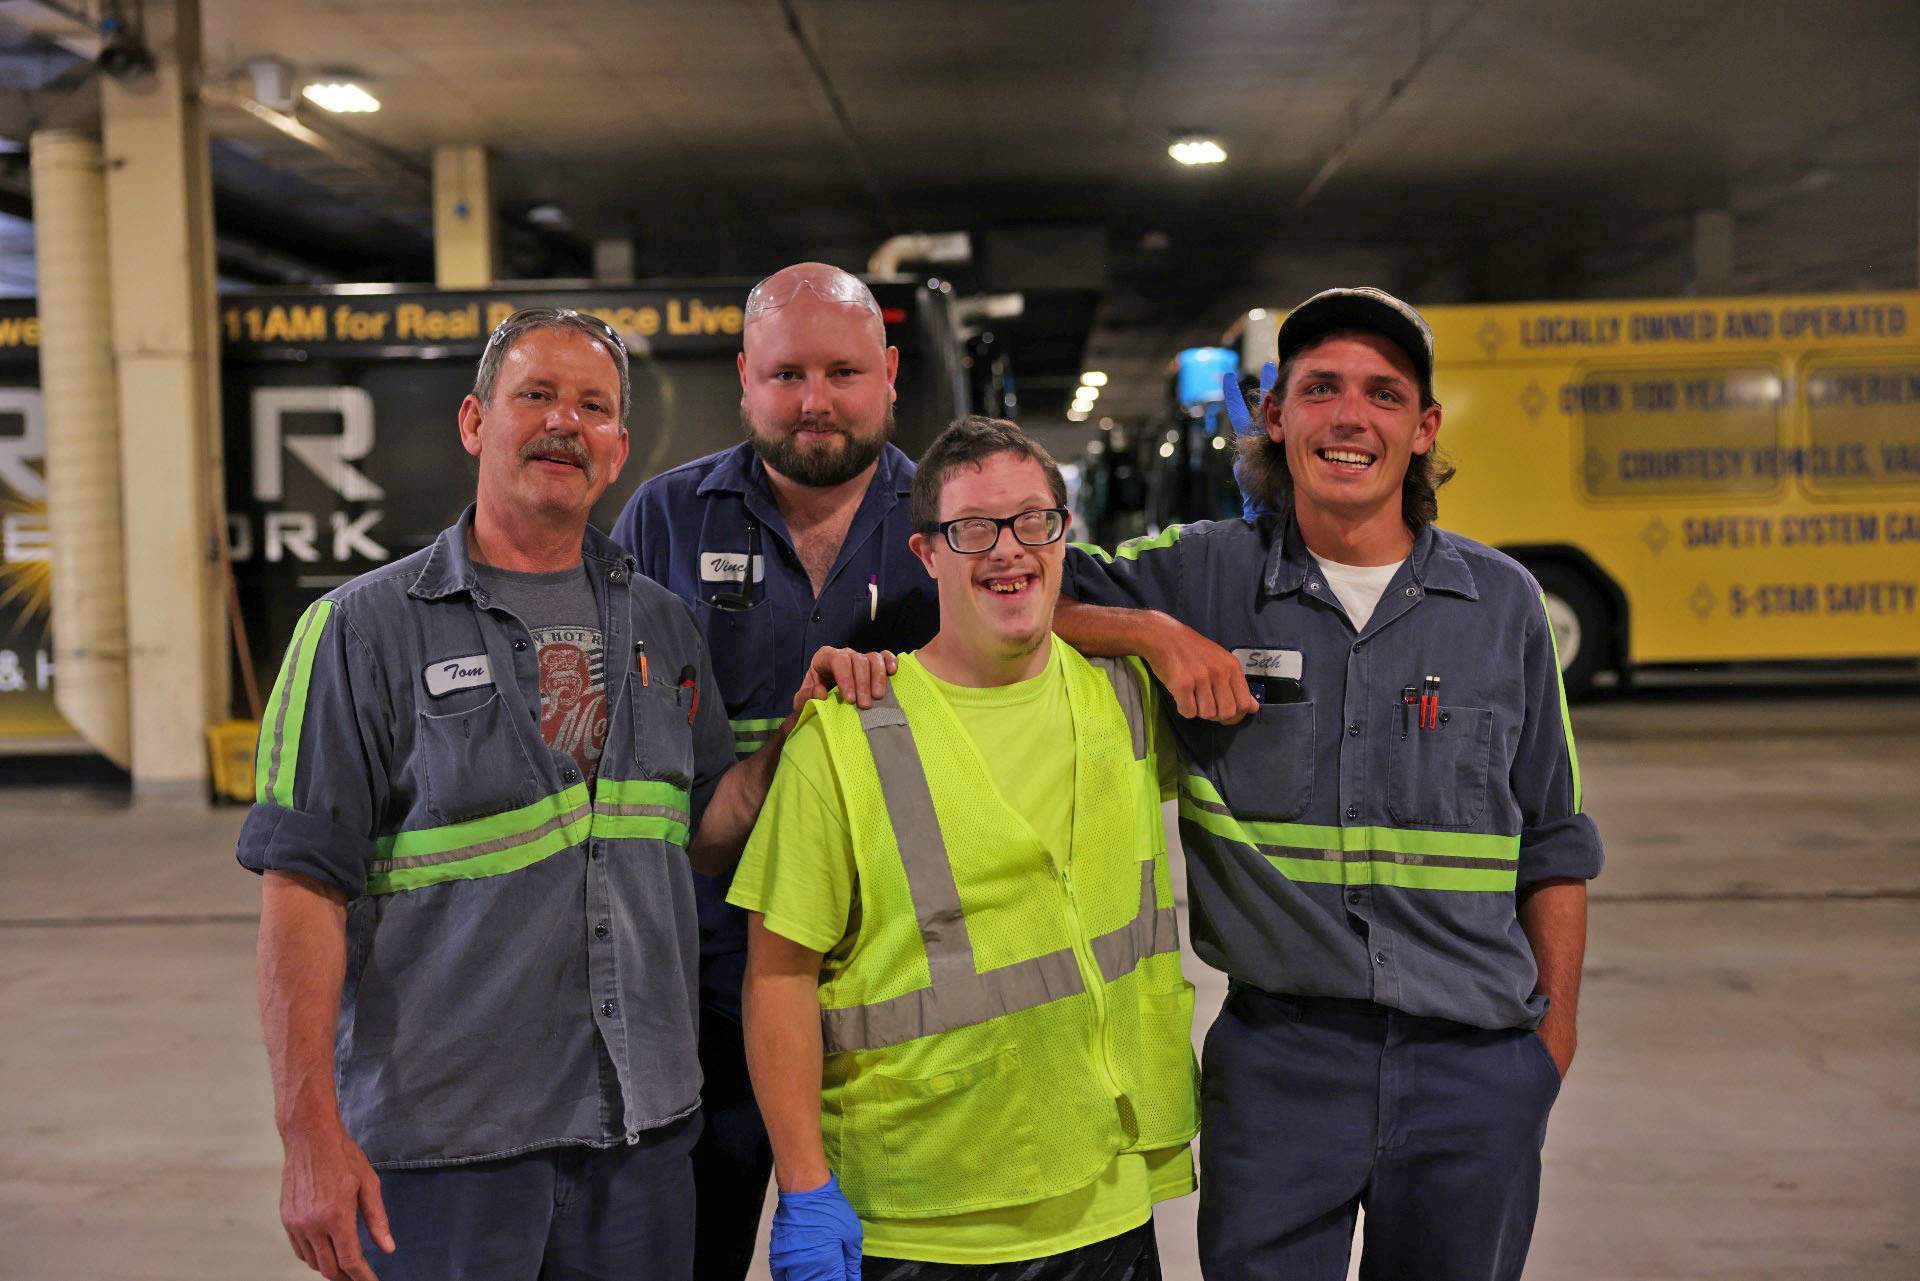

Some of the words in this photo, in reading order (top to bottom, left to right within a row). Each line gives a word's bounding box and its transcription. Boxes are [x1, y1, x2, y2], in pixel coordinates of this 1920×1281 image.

[334, 303, 389, 341] for
[396, 303, 480, 341] Real
[667, 299, 744, 336] Live
[1519, 315, 1623, 349] LOCALLY
[1628, 311, 1718, 345] OWNED
[1724, 309, 1775, 341] AND
[1780, 305, 1906, 339] OPERATED
[1559, 383, 1623, 415] OVER
[252, 386, 387, 500] R
[1619, 447, 1743, 481] COURTESY
[1683, 515, 1772, 548] SAFETY
[1781, 513, 1877, 547] SYSTEM
[711, 559, 747, 572] Vinc
[1730, 583, 1819, 618] 5-STAR
[1826, 580, 1916, 616] SAFETY
[551, 631, 585, 643] HOT
[443, 663, 485, 680] Tom
[1246, 651, 1282, 669] Seth
